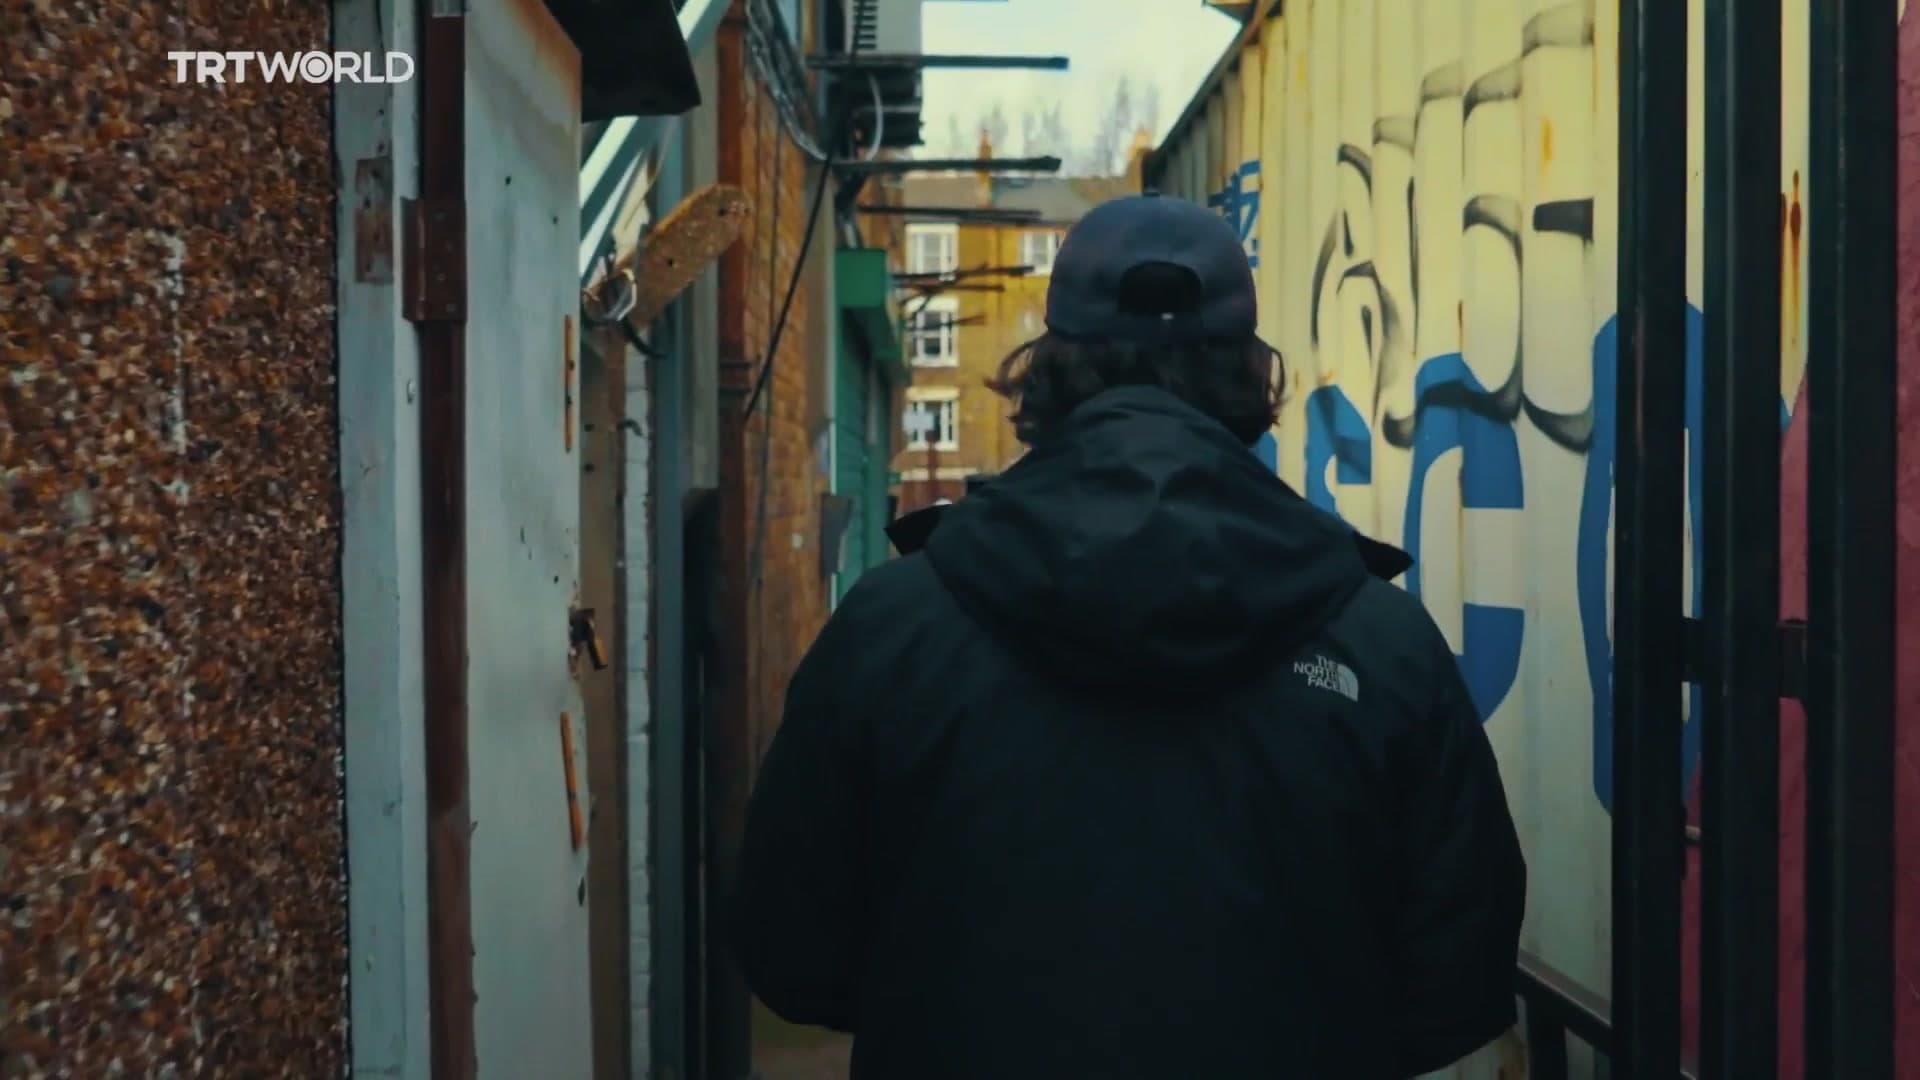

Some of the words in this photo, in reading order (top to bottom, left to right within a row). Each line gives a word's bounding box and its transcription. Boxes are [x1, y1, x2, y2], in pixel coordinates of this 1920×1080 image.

[1293, 661, 1338, 681] NORTH
[1315, 654, 1338, 672] THE
[1307, 675, 1339, 692] FACE
